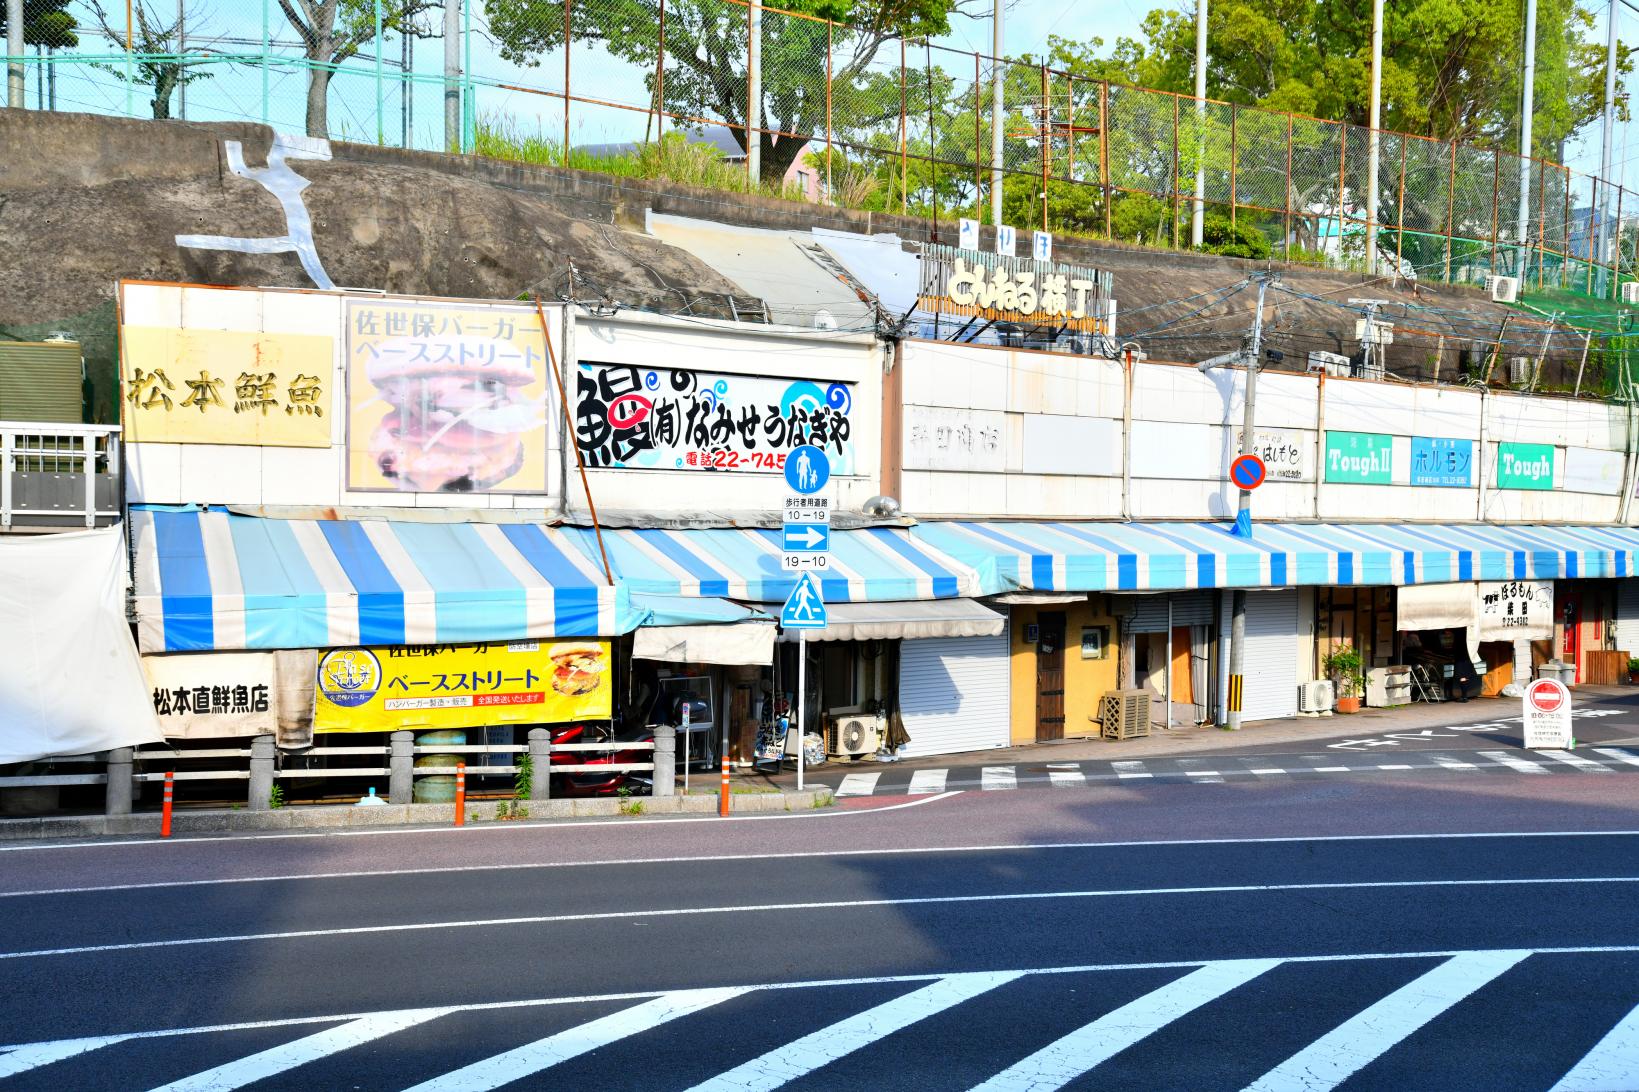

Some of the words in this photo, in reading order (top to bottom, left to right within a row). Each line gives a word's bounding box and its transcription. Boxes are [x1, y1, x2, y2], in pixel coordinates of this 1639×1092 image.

[950, 257, 1093, 318] とんねる横丁
[356, 310, 541, 340] 佐世保バーガー
[356, 340, 541, 368] ベースストリート
[126, 367, 323, 417] 松本鮮魚
[686, 451, 712, 467] 電話
[714, 450, 785, 469] 22-745
[1416, 450, 1469, 473] ホルモン
[1503, 453, 1550, 480] Tough
[785, 498, 828, 508] 歩行者用道路
[788, 510, 825, 520] 10-19
[785, 556, 826, 567] 19-10
[1501, 581, 1533, 600] ほるもん
[388, 669, 540, 692] ベースストリート
[153, 684, 269, 716] 松本直鮮魚店
[478, 694, 539, 705] 全国発送いたします
